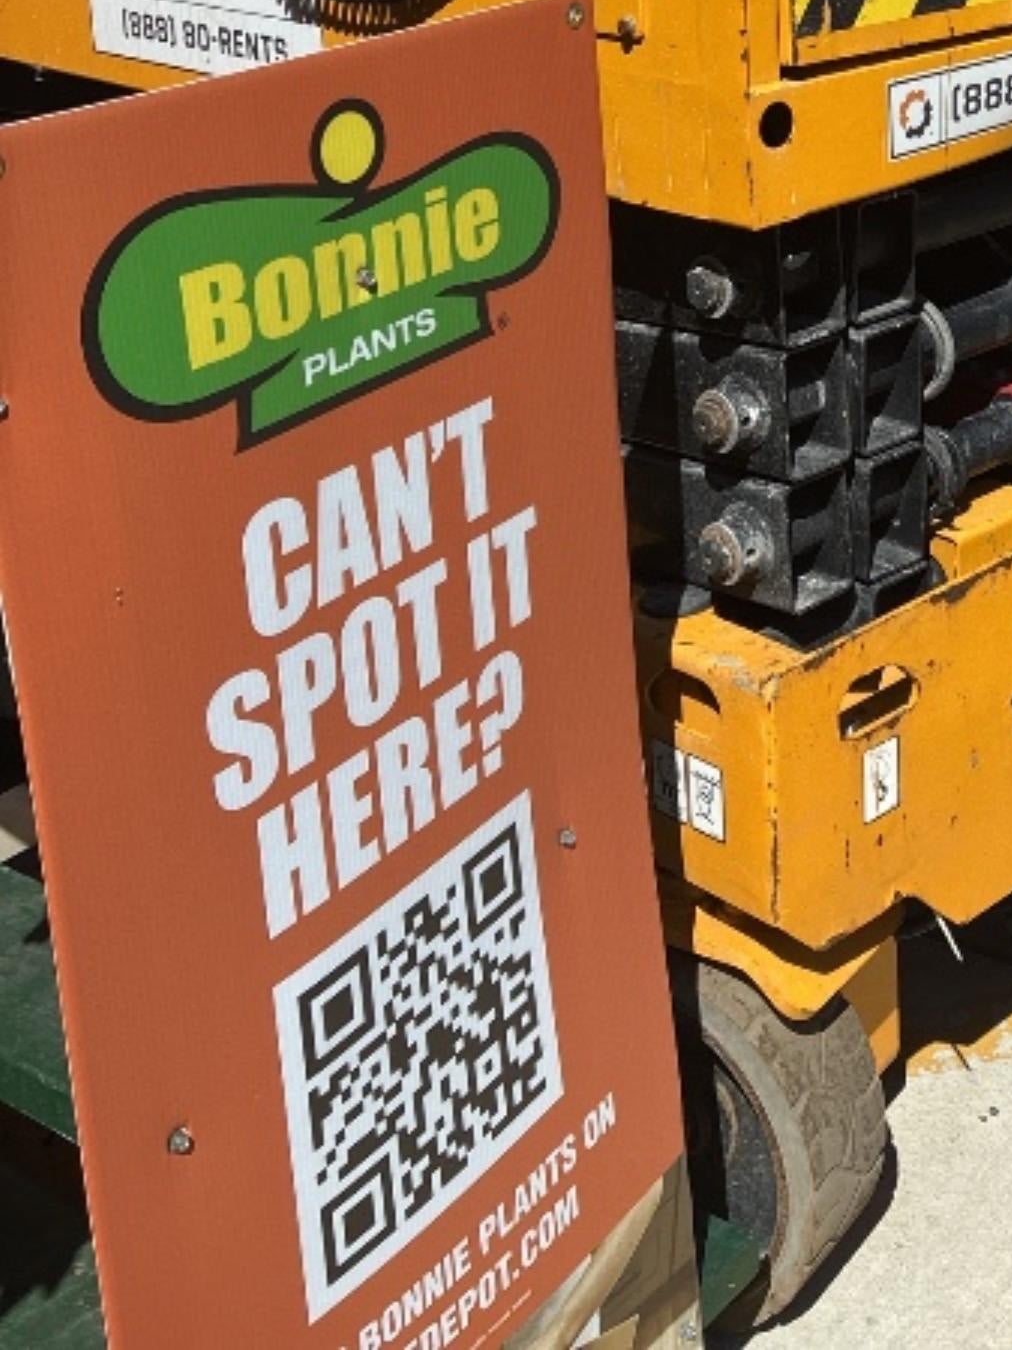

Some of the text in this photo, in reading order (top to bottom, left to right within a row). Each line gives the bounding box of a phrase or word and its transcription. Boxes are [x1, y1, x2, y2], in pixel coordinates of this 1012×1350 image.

[121, 8, 177, 47] (888)
[179, 186, 500, 371] Bonnie
[301, 308, 438, 387] PLANTS
[242, 397, 493, 637] CAN'T
[206, 505, 537, 812] SPOT IT
[257, 650, 524, 941] HERE?
[359, 1235, 472, 1350] BONNIE
[479, 1132, 577, 1255] PLANTS
[582, 1091, 616, 1149] ON
